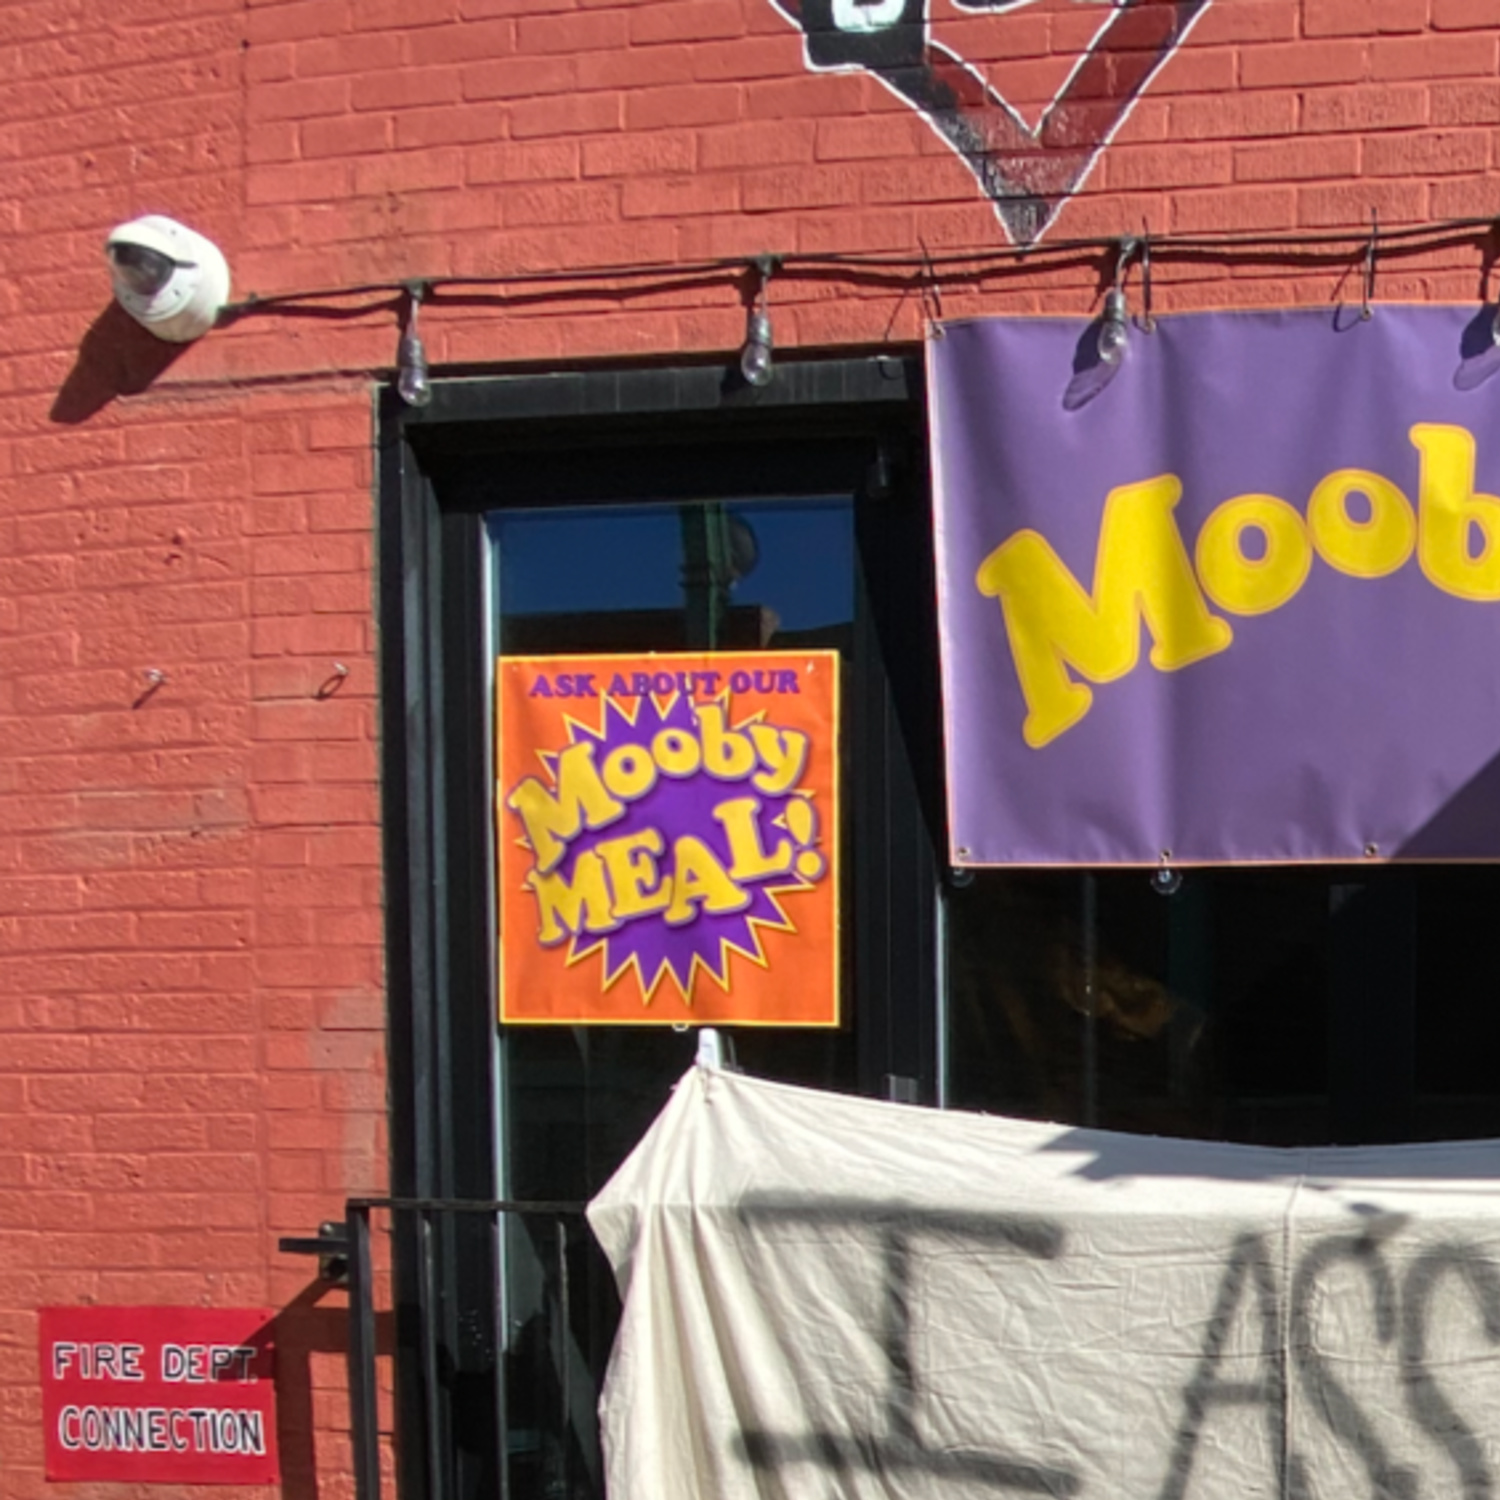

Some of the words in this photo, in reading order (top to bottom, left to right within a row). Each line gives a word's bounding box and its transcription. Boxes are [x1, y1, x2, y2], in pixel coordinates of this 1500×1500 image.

[529, 674, 598, 698] ASK
[606, 671, 721, 697] ABOUT
[729, 670, 800, 694] OUR
[508, 701, 808, 874] Mooby
[528, 797, 826, 948] MEAL!
[53, 1342, 145, 1380] FIRE
[162, 1344, 258, 1383] DEPT.
[733, 1192, 1082, 1500] I
[58, 1405, 266, 1455] CONNECTION
